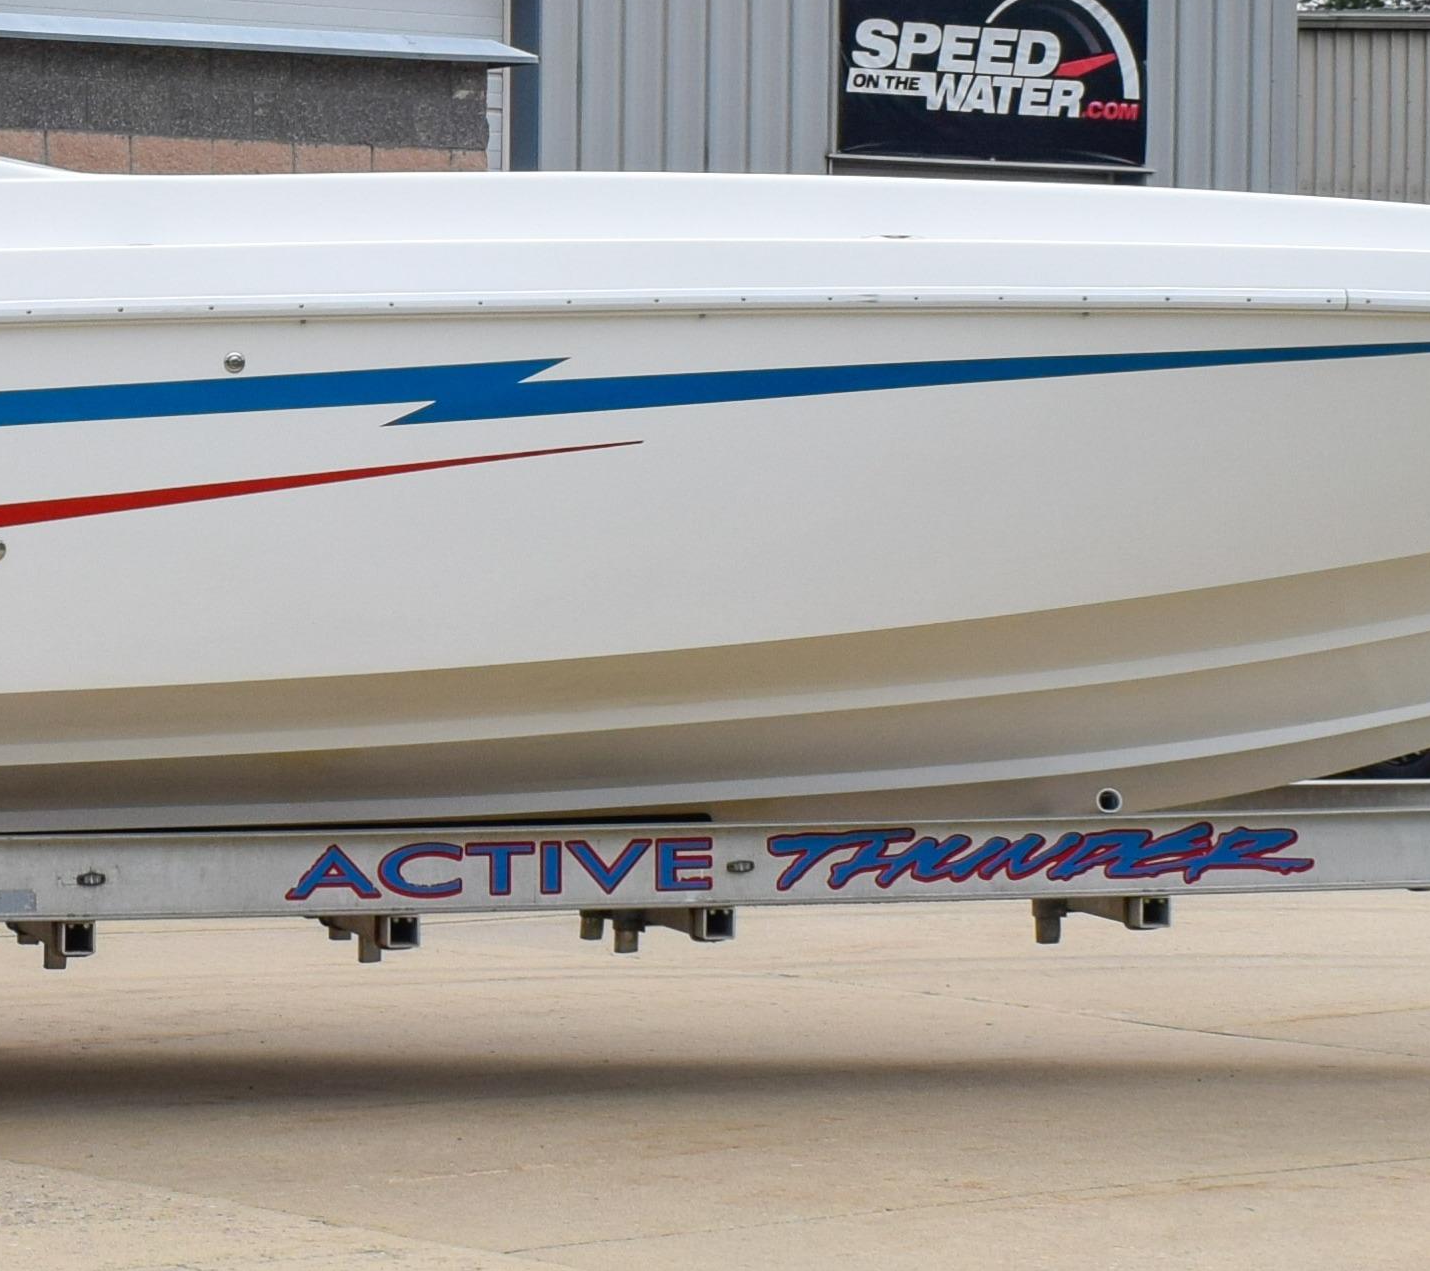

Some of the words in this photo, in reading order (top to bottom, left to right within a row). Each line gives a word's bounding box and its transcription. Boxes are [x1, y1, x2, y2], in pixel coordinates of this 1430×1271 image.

[851, 18, 1062, 78] SPEED
[852, 72, 880, 89] ON
[885, 74, 922, 92] THE
[284, 836, 714, 901] ACTIVE
[766, 820, 1316, 892] THUNDER
